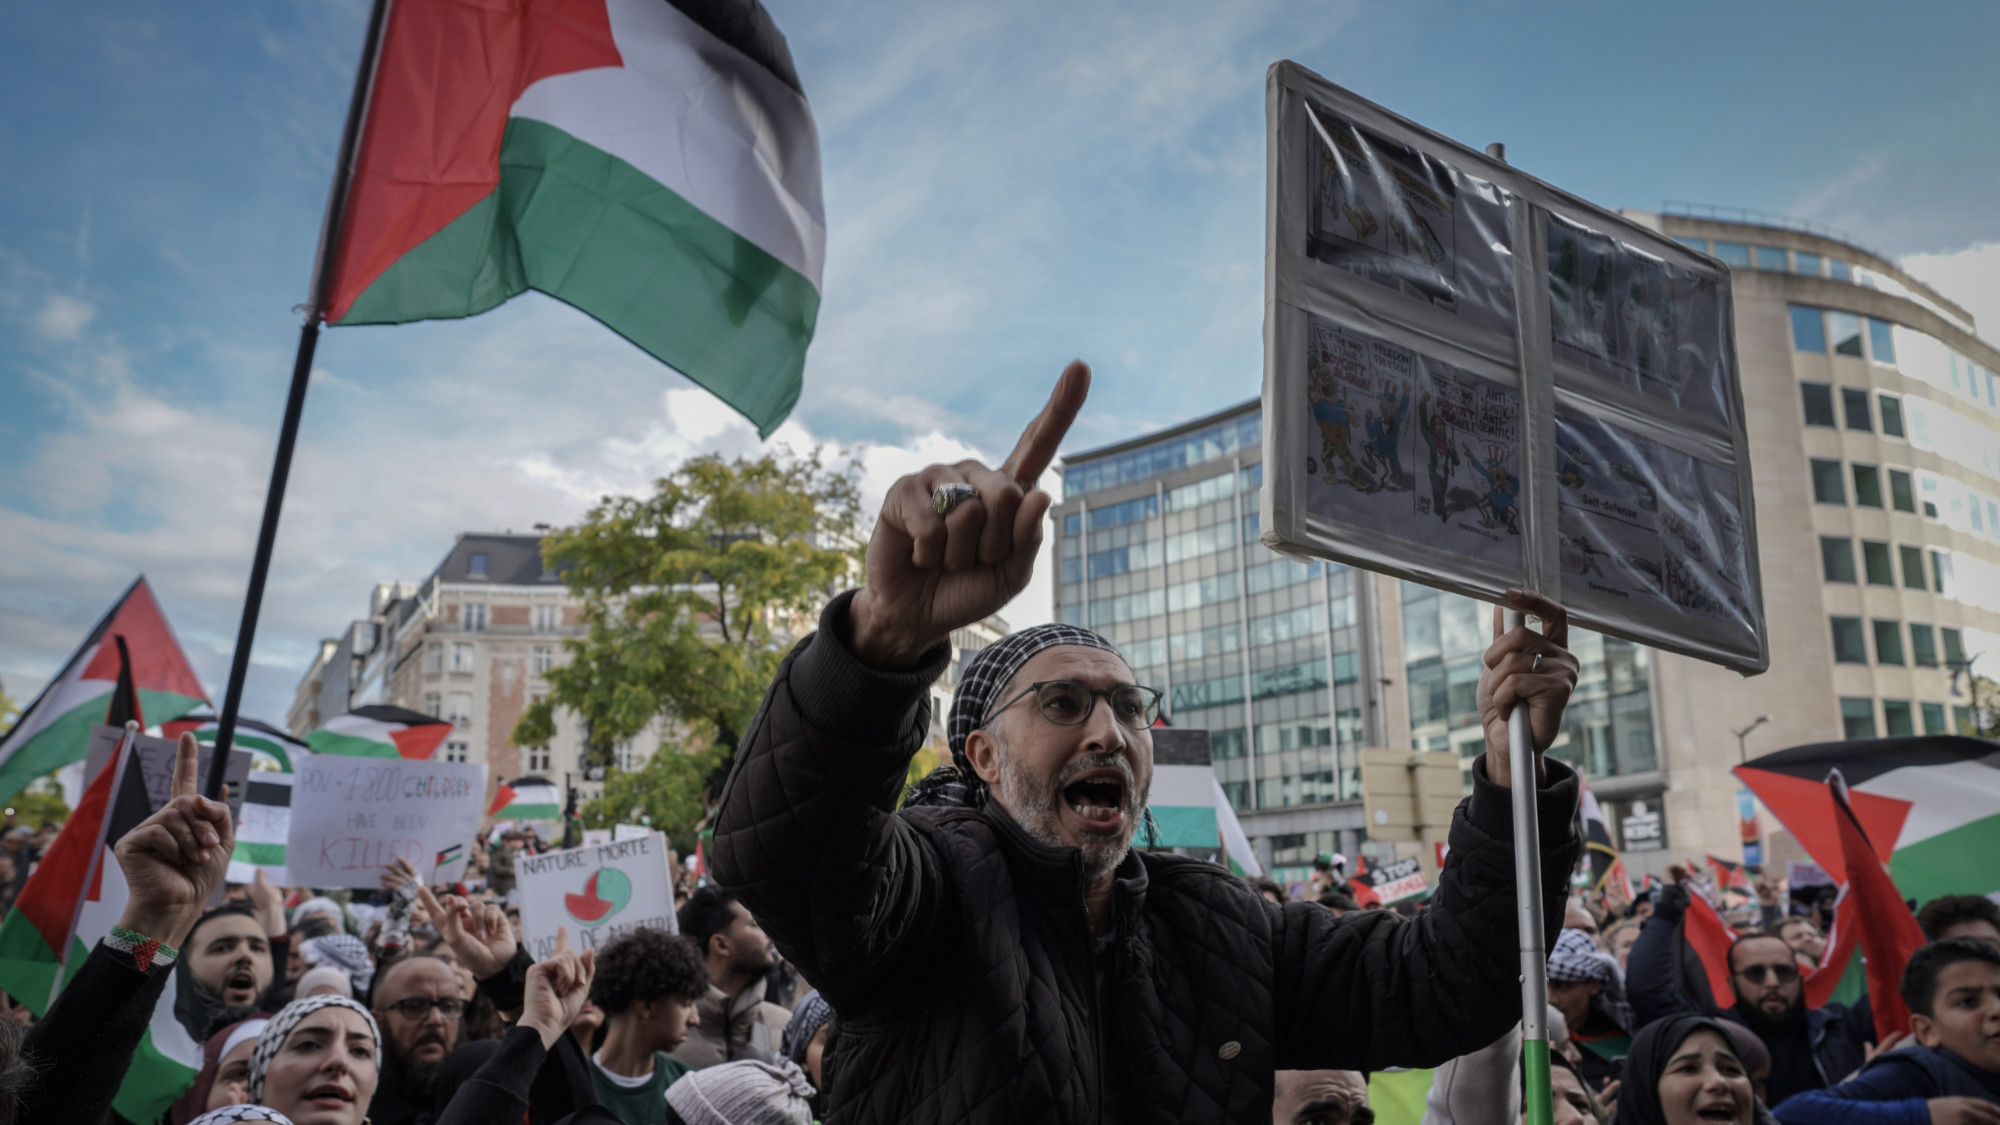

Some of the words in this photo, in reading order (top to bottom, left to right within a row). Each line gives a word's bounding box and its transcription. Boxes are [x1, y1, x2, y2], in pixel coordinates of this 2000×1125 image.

[1322, 351, 1367, 377] BOYCOTT
[1582, 494, 1638, 518] Self-defense
[1588, 581, 1630, 598] terrorism
[392, 814, 430, 830] BEEN
[1623, 823, 1661, 840] KBC
[320, 837, 424, 871] KILLED
[522, 850, 587, 876] NATURE
[596, 839, 652, 864] MORTE
[1371, 858, 1416, 885] STOP
